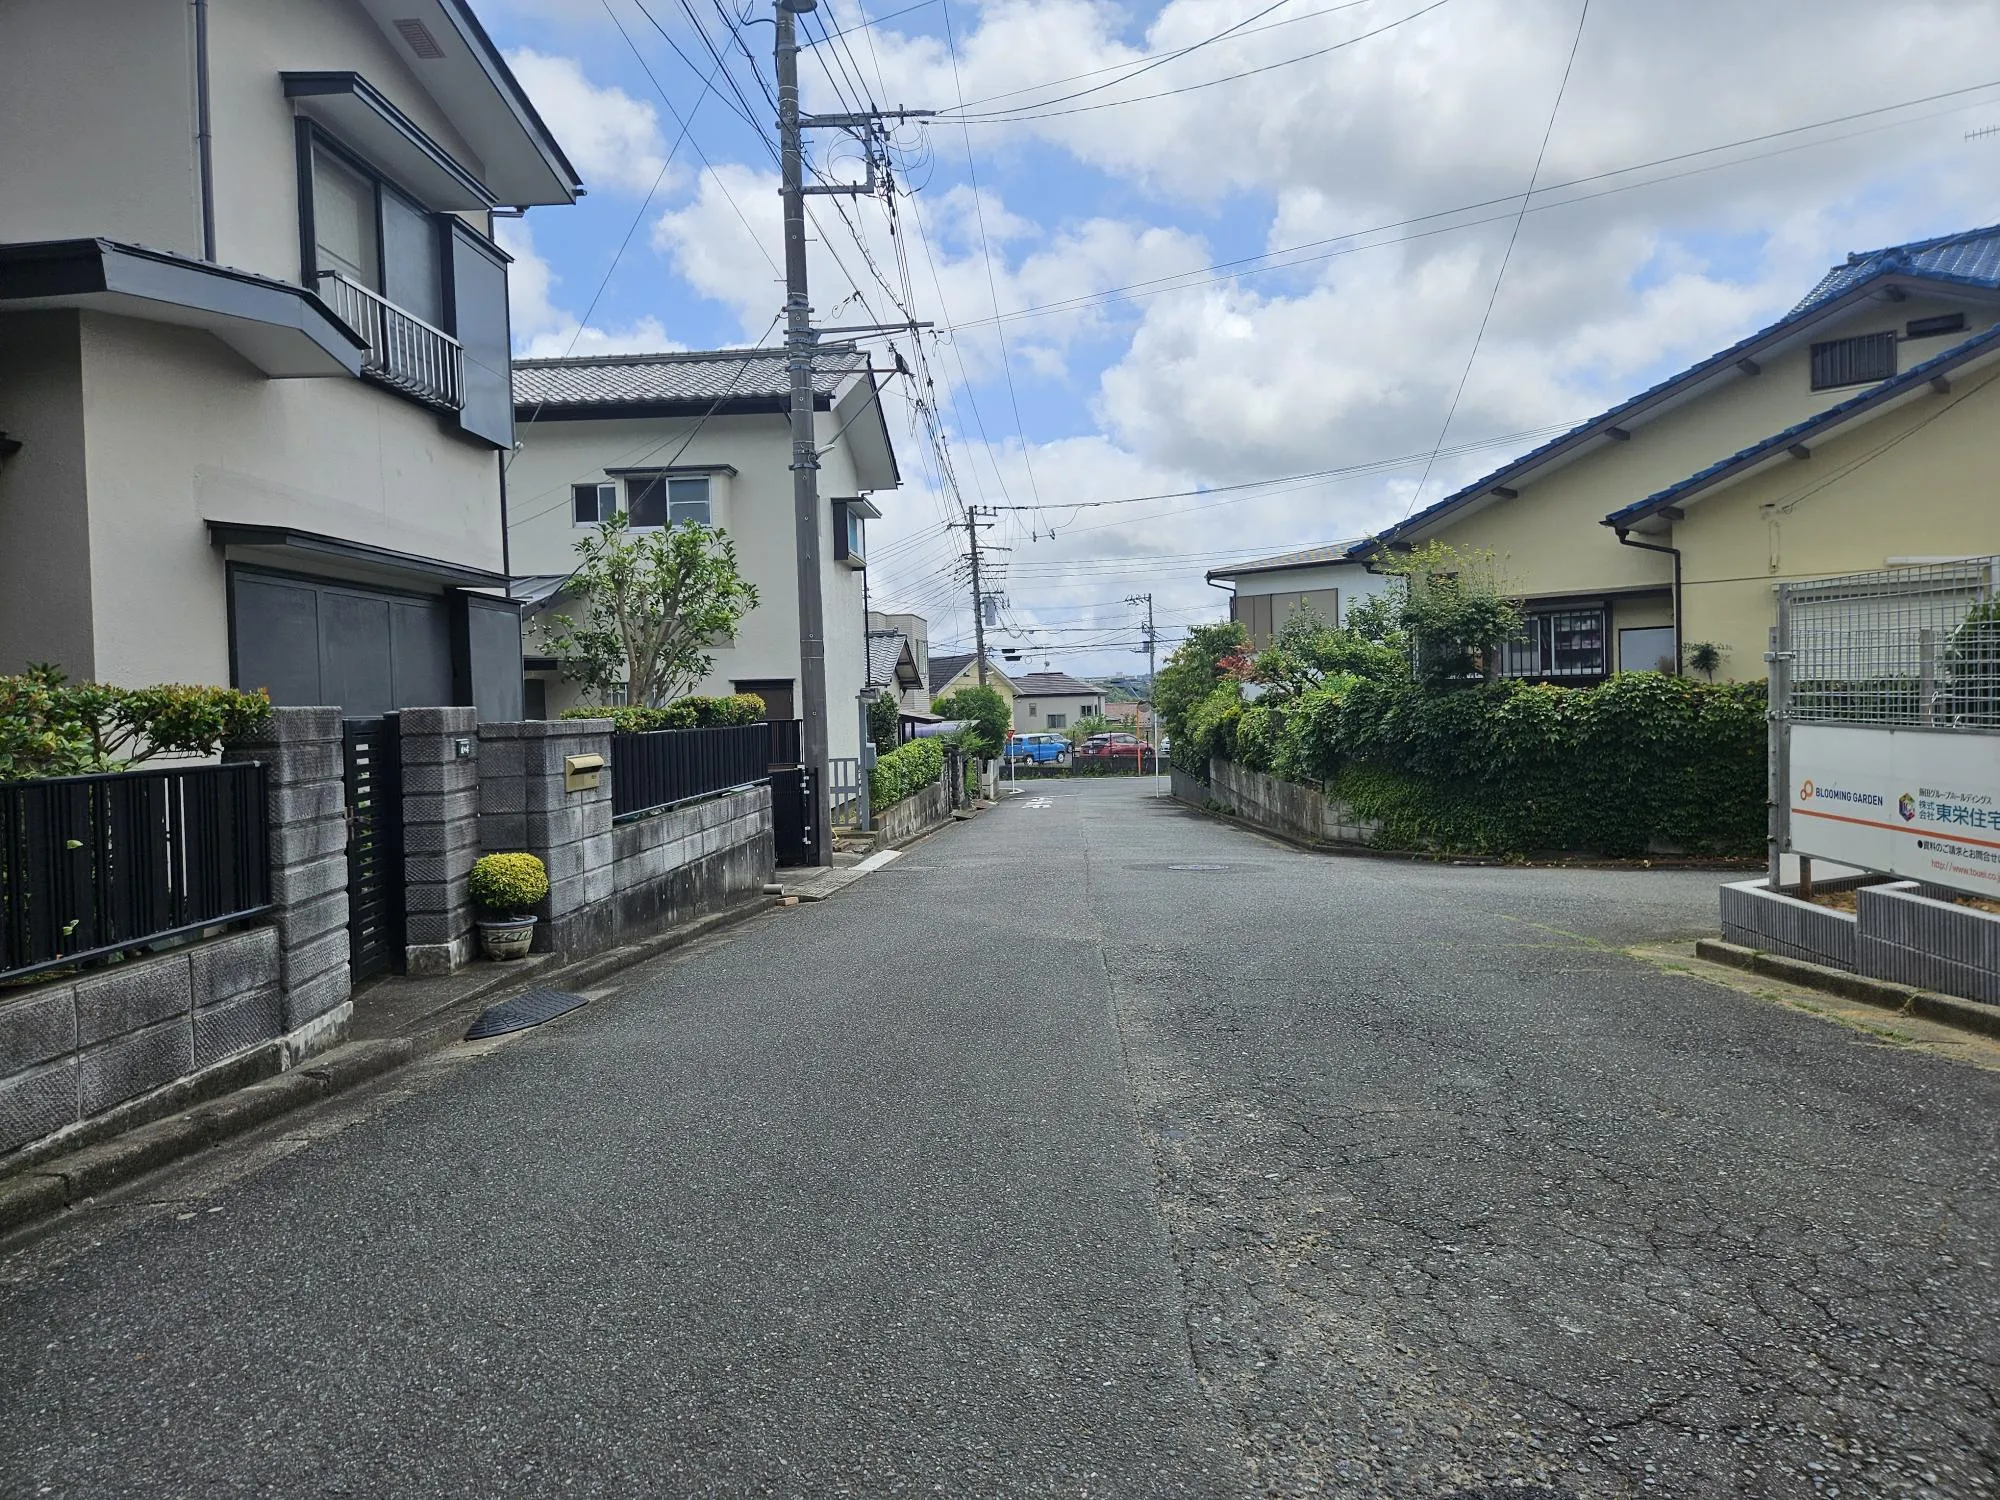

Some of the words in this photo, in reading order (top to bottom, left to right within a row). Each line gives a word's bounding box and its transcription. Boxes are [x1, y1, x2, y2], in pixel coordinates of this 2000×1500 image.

[1815, 787, 1852, 802] BLOOMING
[1852, 792, 1884, 806] GARDEN
[1935, 803, 2000, 831] 東栄住宅
